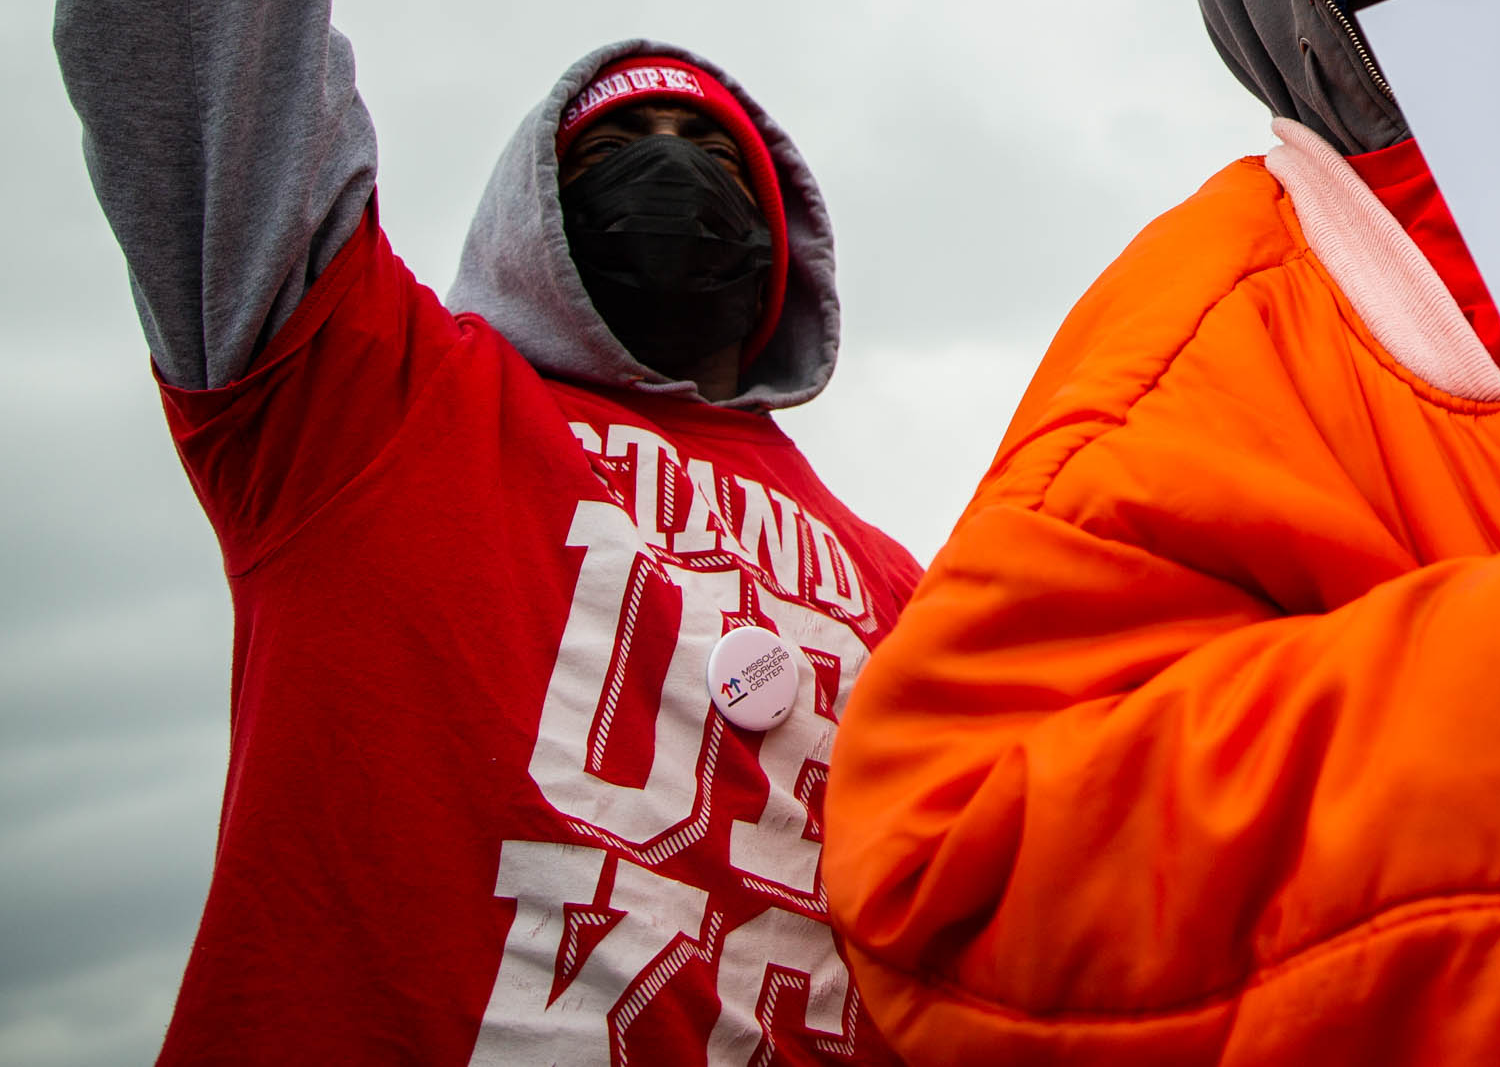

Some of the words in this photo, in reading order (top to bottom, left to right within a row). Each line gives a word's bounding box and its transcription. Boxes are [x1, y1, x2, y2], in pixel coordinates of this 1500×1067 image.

[627, 68, 660, 90] UP
[661, 67, 697, 92] KC
[741, 646, 782, 677] MISSOURI
[745, 651, 790, 684] WORKERS
[750, 665, 785, 692] CENTER
